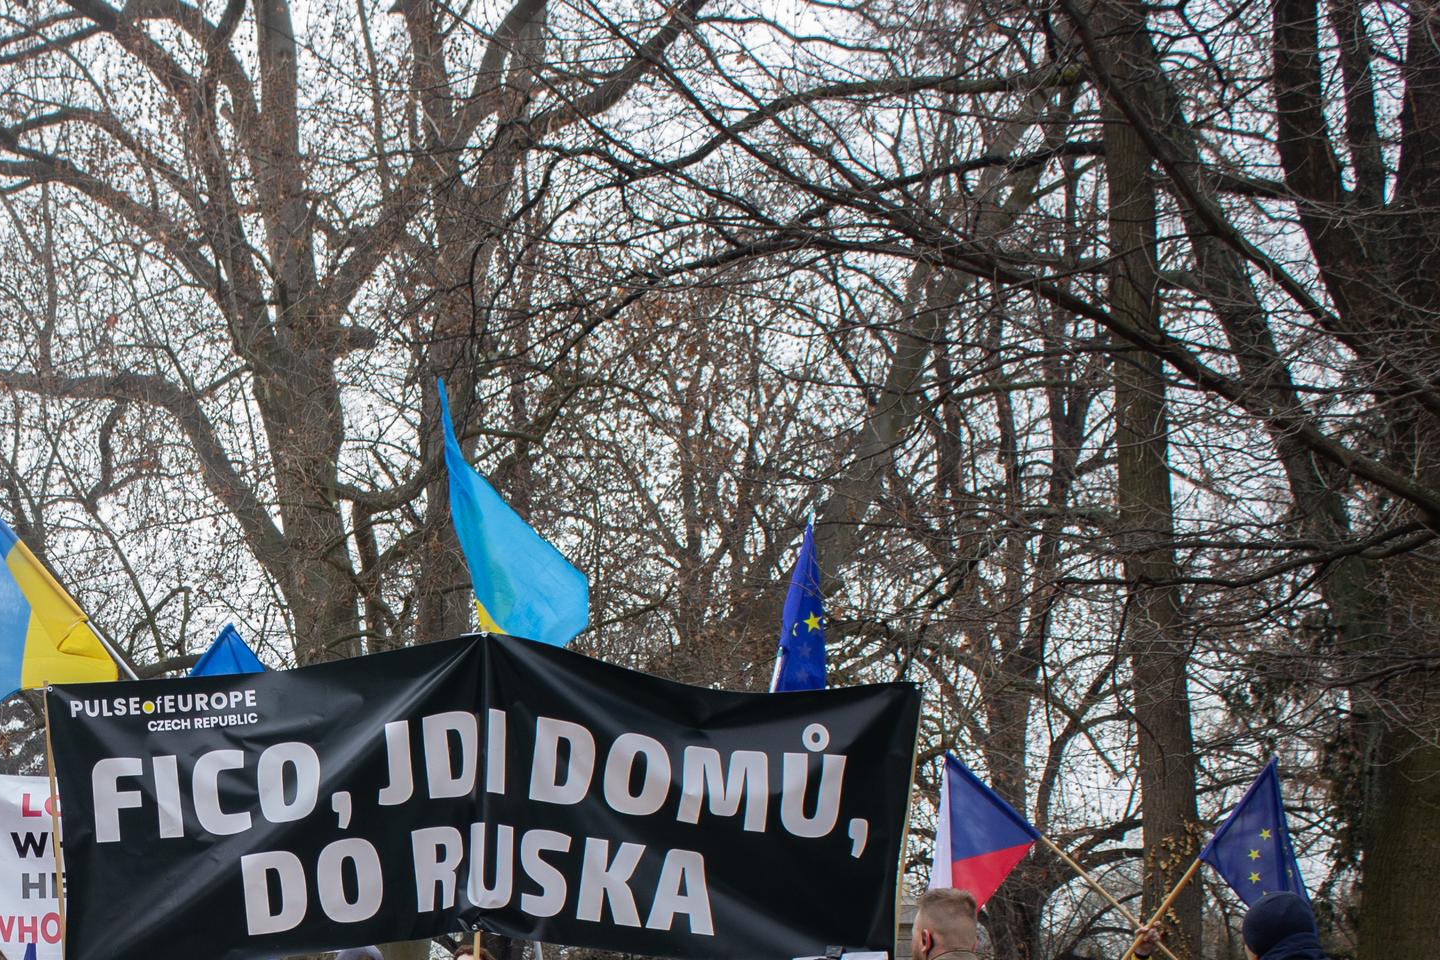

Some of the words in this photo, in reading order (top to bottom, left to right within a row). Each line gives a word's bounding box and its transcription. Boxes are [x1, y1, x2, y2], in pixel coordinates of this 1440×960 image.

[147, 720, 191, 732] CZECH
[194, 712, 258, 729] REPUBLIC
[91, 741, 352, 843] FICO,
[378, 708, 506, 806] JDI
[528, 716, 868, 858] DOMŮ,
[241, 837, 383, 936] DO
[410, 821, 715, 936] RUSKA
